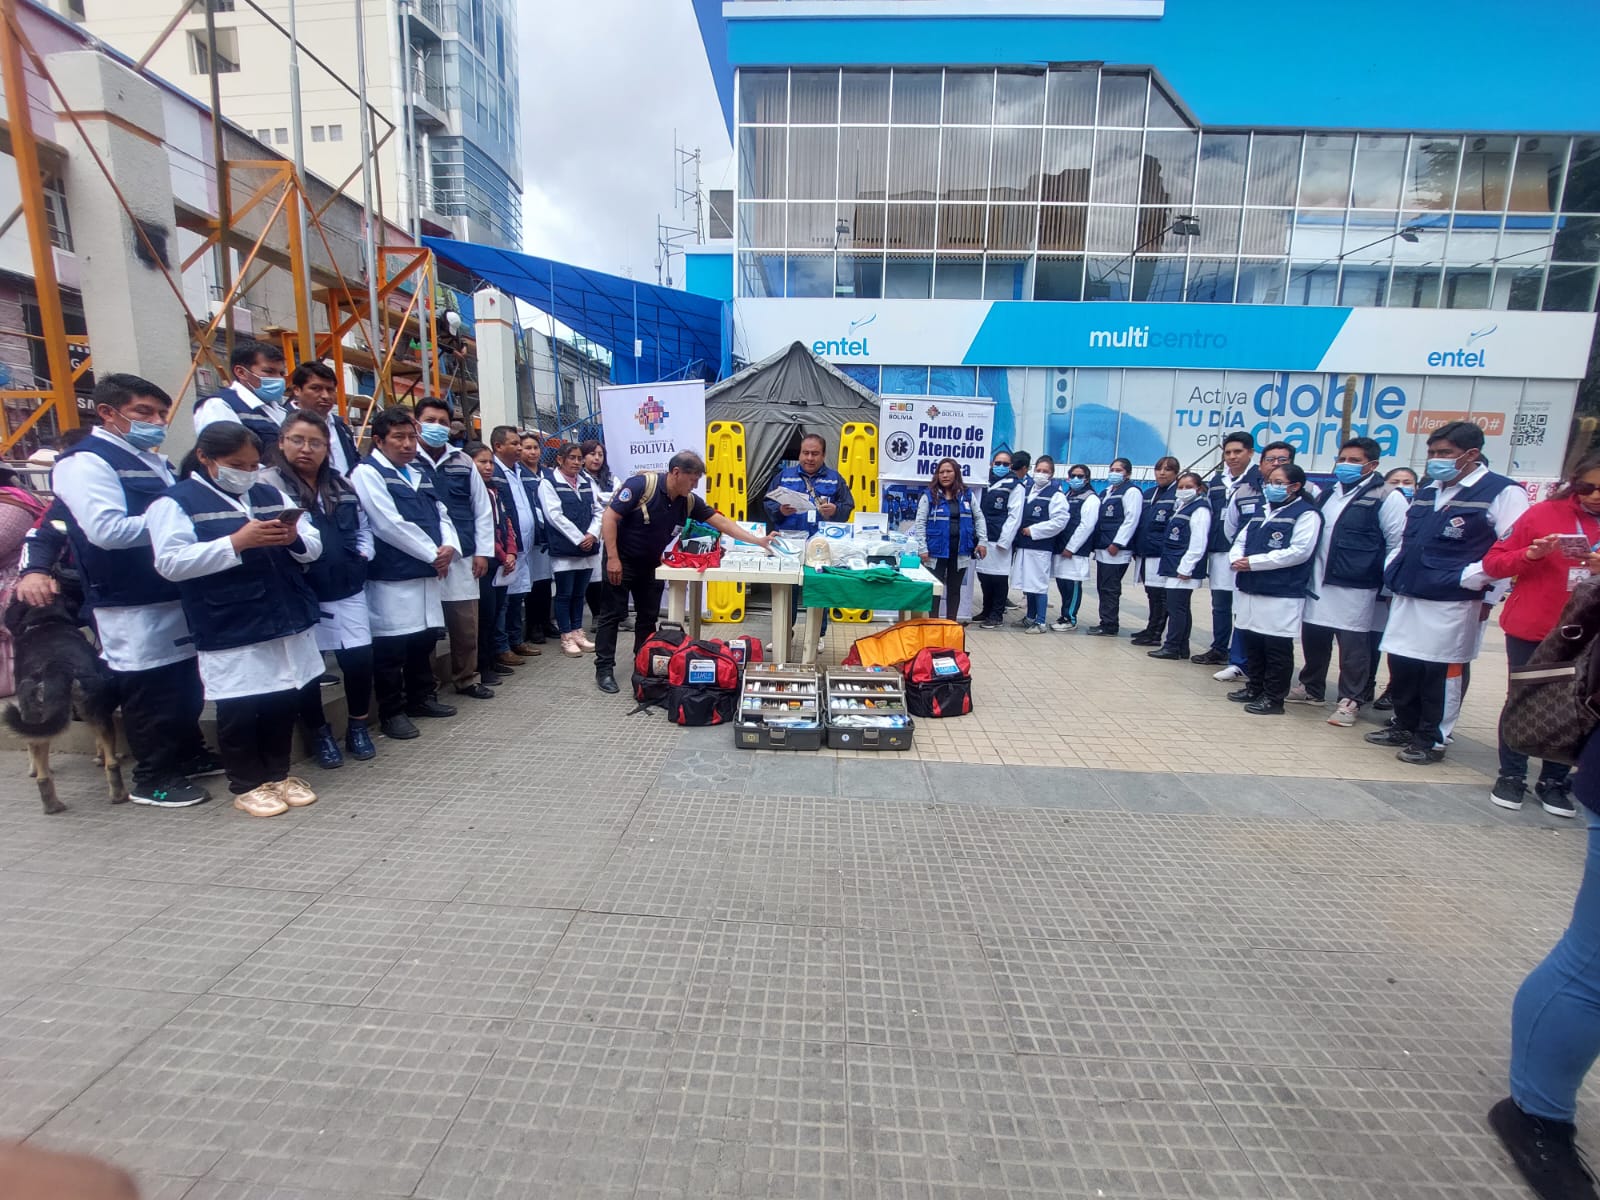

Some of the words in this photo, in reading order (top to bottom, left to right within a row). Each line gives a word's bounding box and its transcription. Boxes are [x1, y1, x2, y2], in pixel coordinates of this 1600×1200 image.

[812, 337, 870, 356] entel
[1427, 348, 1485, 368] entel
[1188, 386, 1248, 405] Activa
[1253, 373, 1407, 420] doble
[1175, 409, 1204, 428] TU
[1208, 406, 1246, 428] DÍA
[919, 422, 962, 440] Punto
[965, 425, 984, 441] de
[630, 443, 675, 454] BOLIVIA
[918, 440, 985, 459] Atención
[917, 459, 971, 477] Méa
